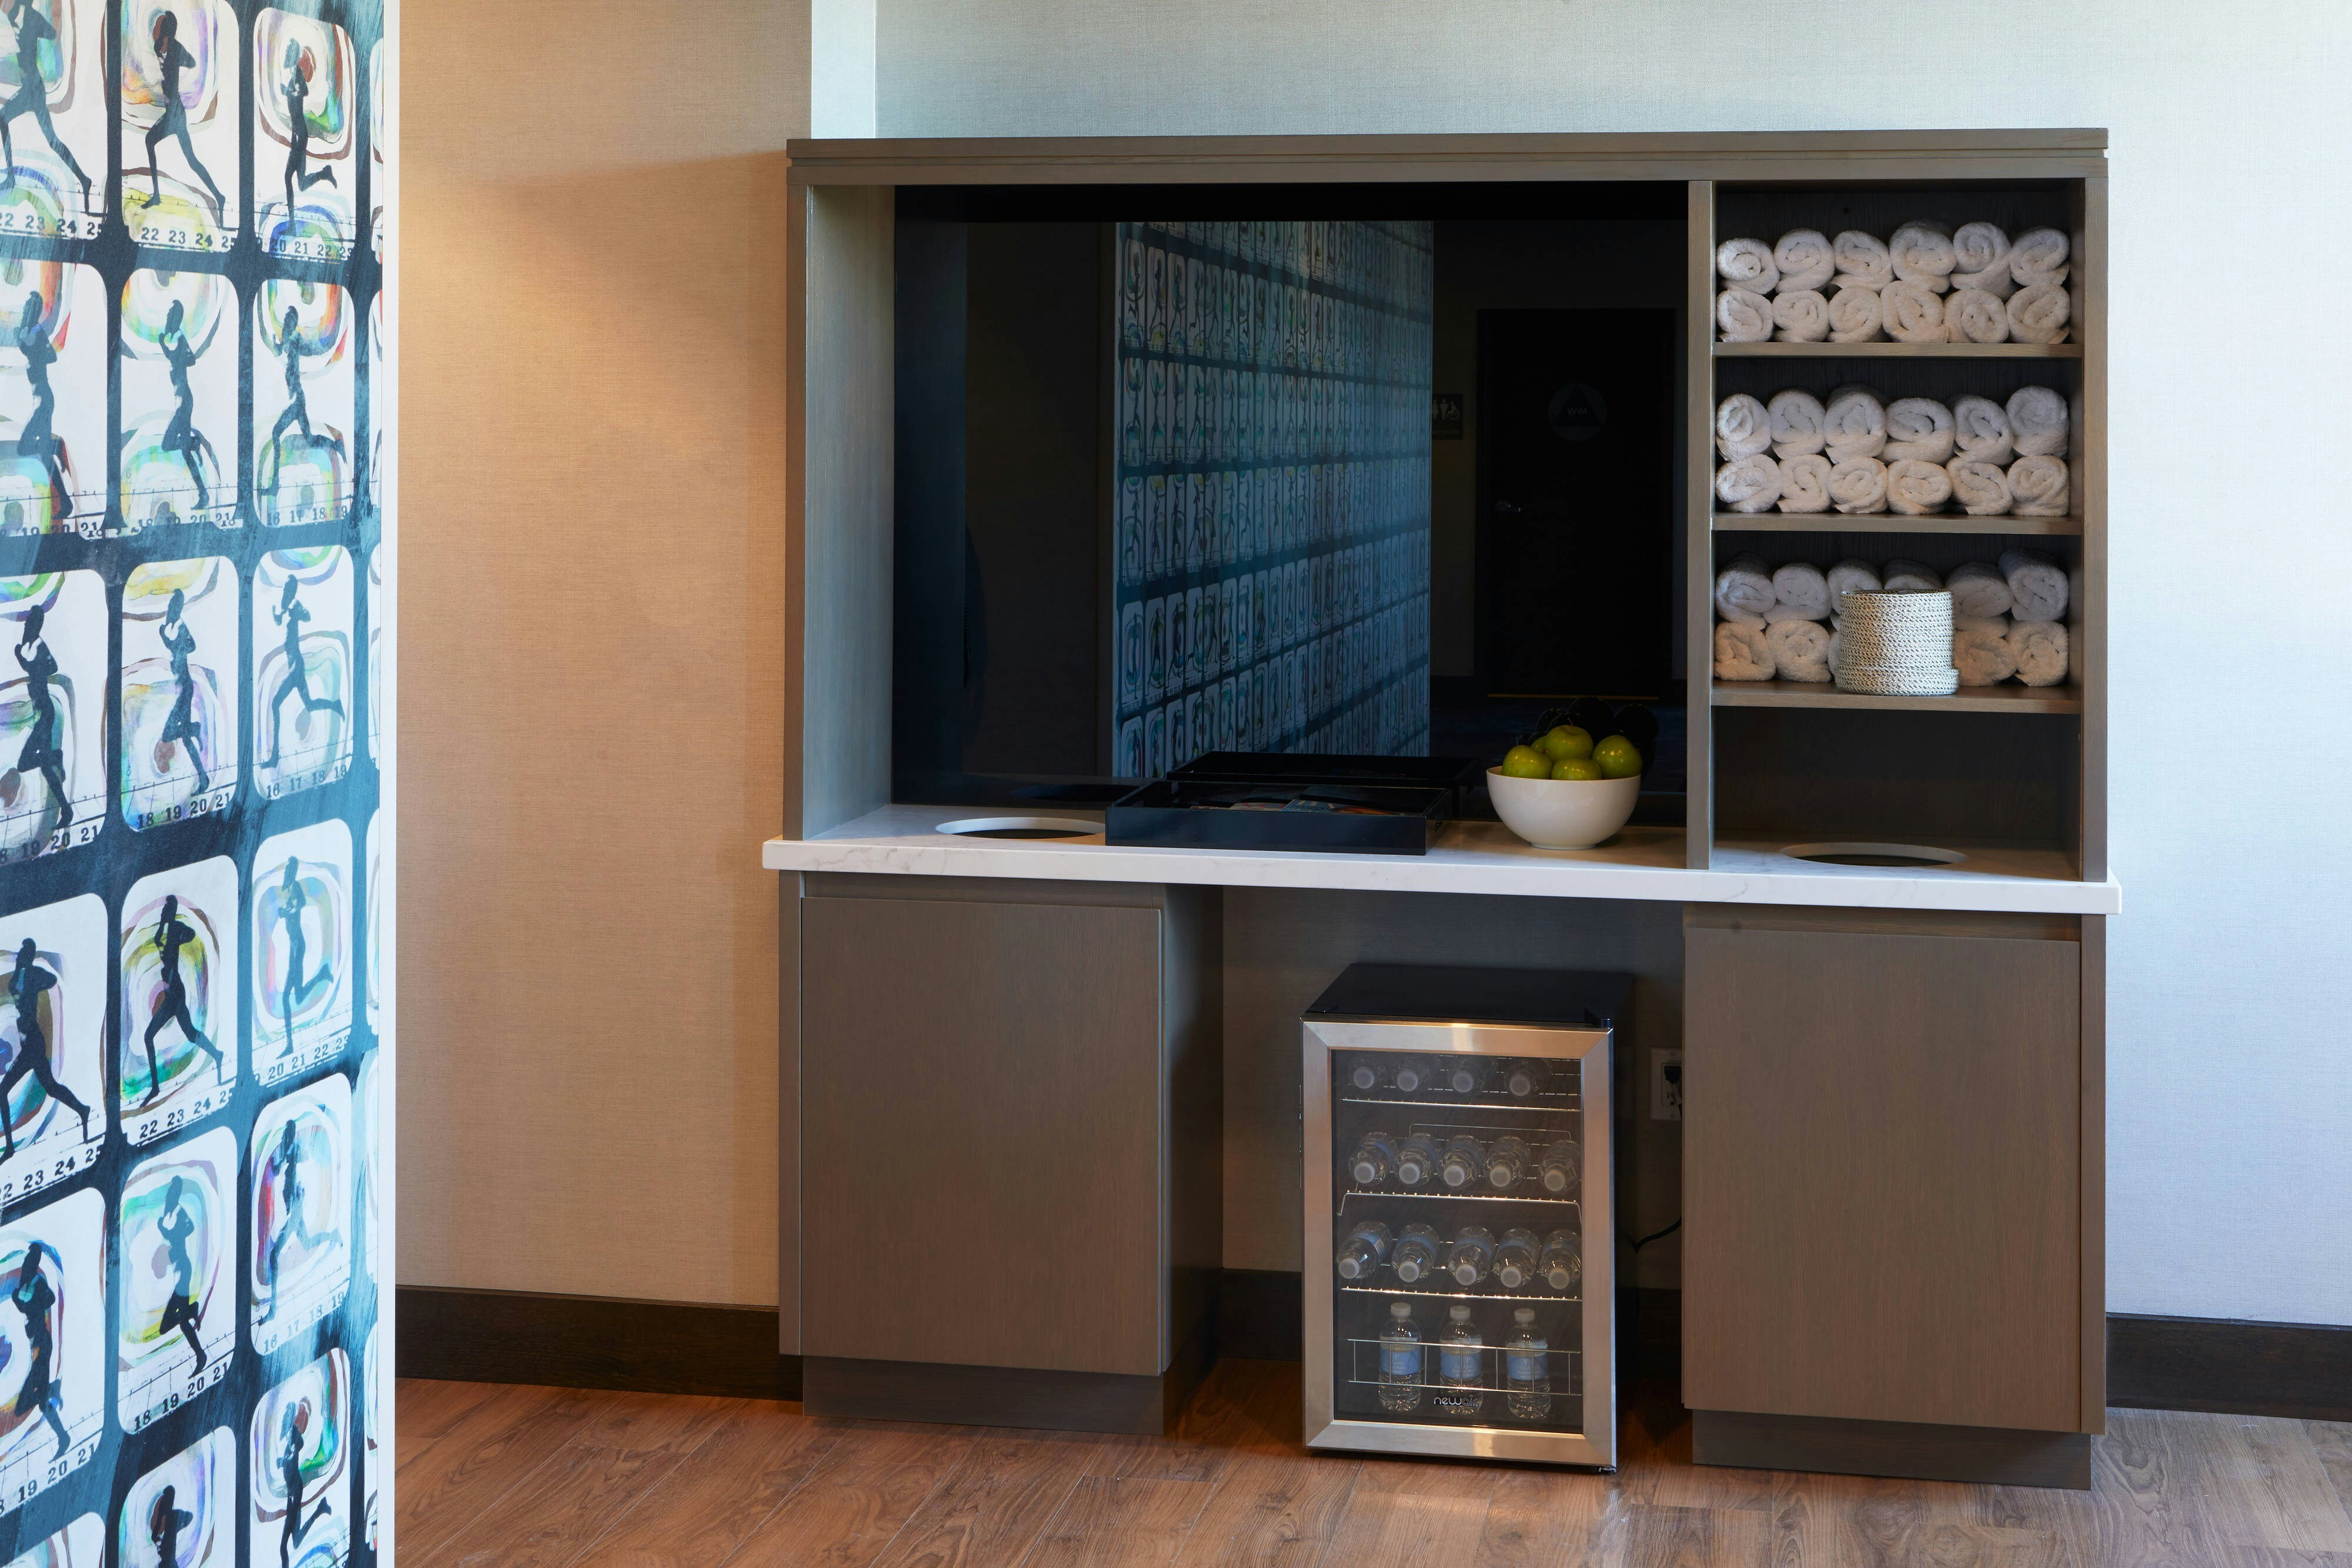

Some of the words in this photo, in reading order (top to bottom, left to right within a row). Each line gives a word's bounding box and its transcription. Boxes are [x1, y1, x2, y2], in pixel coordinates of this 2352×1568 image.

[0, 213, 14, 228] 2
[25, 215, 45, 230] 23
[56, 218, 77, 233] 24
[141, 227, 159, 241] 22
[169, 230, 186, 244] 23
[195, 233, 213, 247] 24
[295, 241, 308, 255] 21
[318, 244, 332, 257] 22
[313, 507, 326, 520] 18
[289, 777, 302, 791] 17
[312, 770, 325, 784] 18
[334, 764, 347, 779] 19
[138, 812, 154, 829] 18
[165, 805, 182, 821] 19
[190, 798, 206, 815] 20
[215, 793, 230, 808] 21
[22, 840, 41, 859] 19
[51, 832, 71, 851] 20
[81, 825, 98, 842] 21
[268, 1063, 284, 1080] 20
[292, 1053, 305, 1070] 21
[314, 1044, 329, 1060] 22
[140, 1120, 158, 1139] 22
[167, 1109, 184, 1128] 23
[193, 1097, 211, 1115] 24
[24, 1170, 44, 1191] 23
[55, 1156, 75, 1176] 24
[310, 1305, 323, 1322] 18
[331, 1291, 345, 1309] 19
[134, 1409, 151, 1432] 18
[162, 1393, 179, 1414] 19
[188, 1376, 205, 1398] 20
[213, 1362, 228, 1382] 21
[1434, 1394, 1478, 1406] newair
[18, 1479, 37, 1503] 19
[48, 1460, 68, 1485] 20
[78, 1443, 95, 1465] 21
